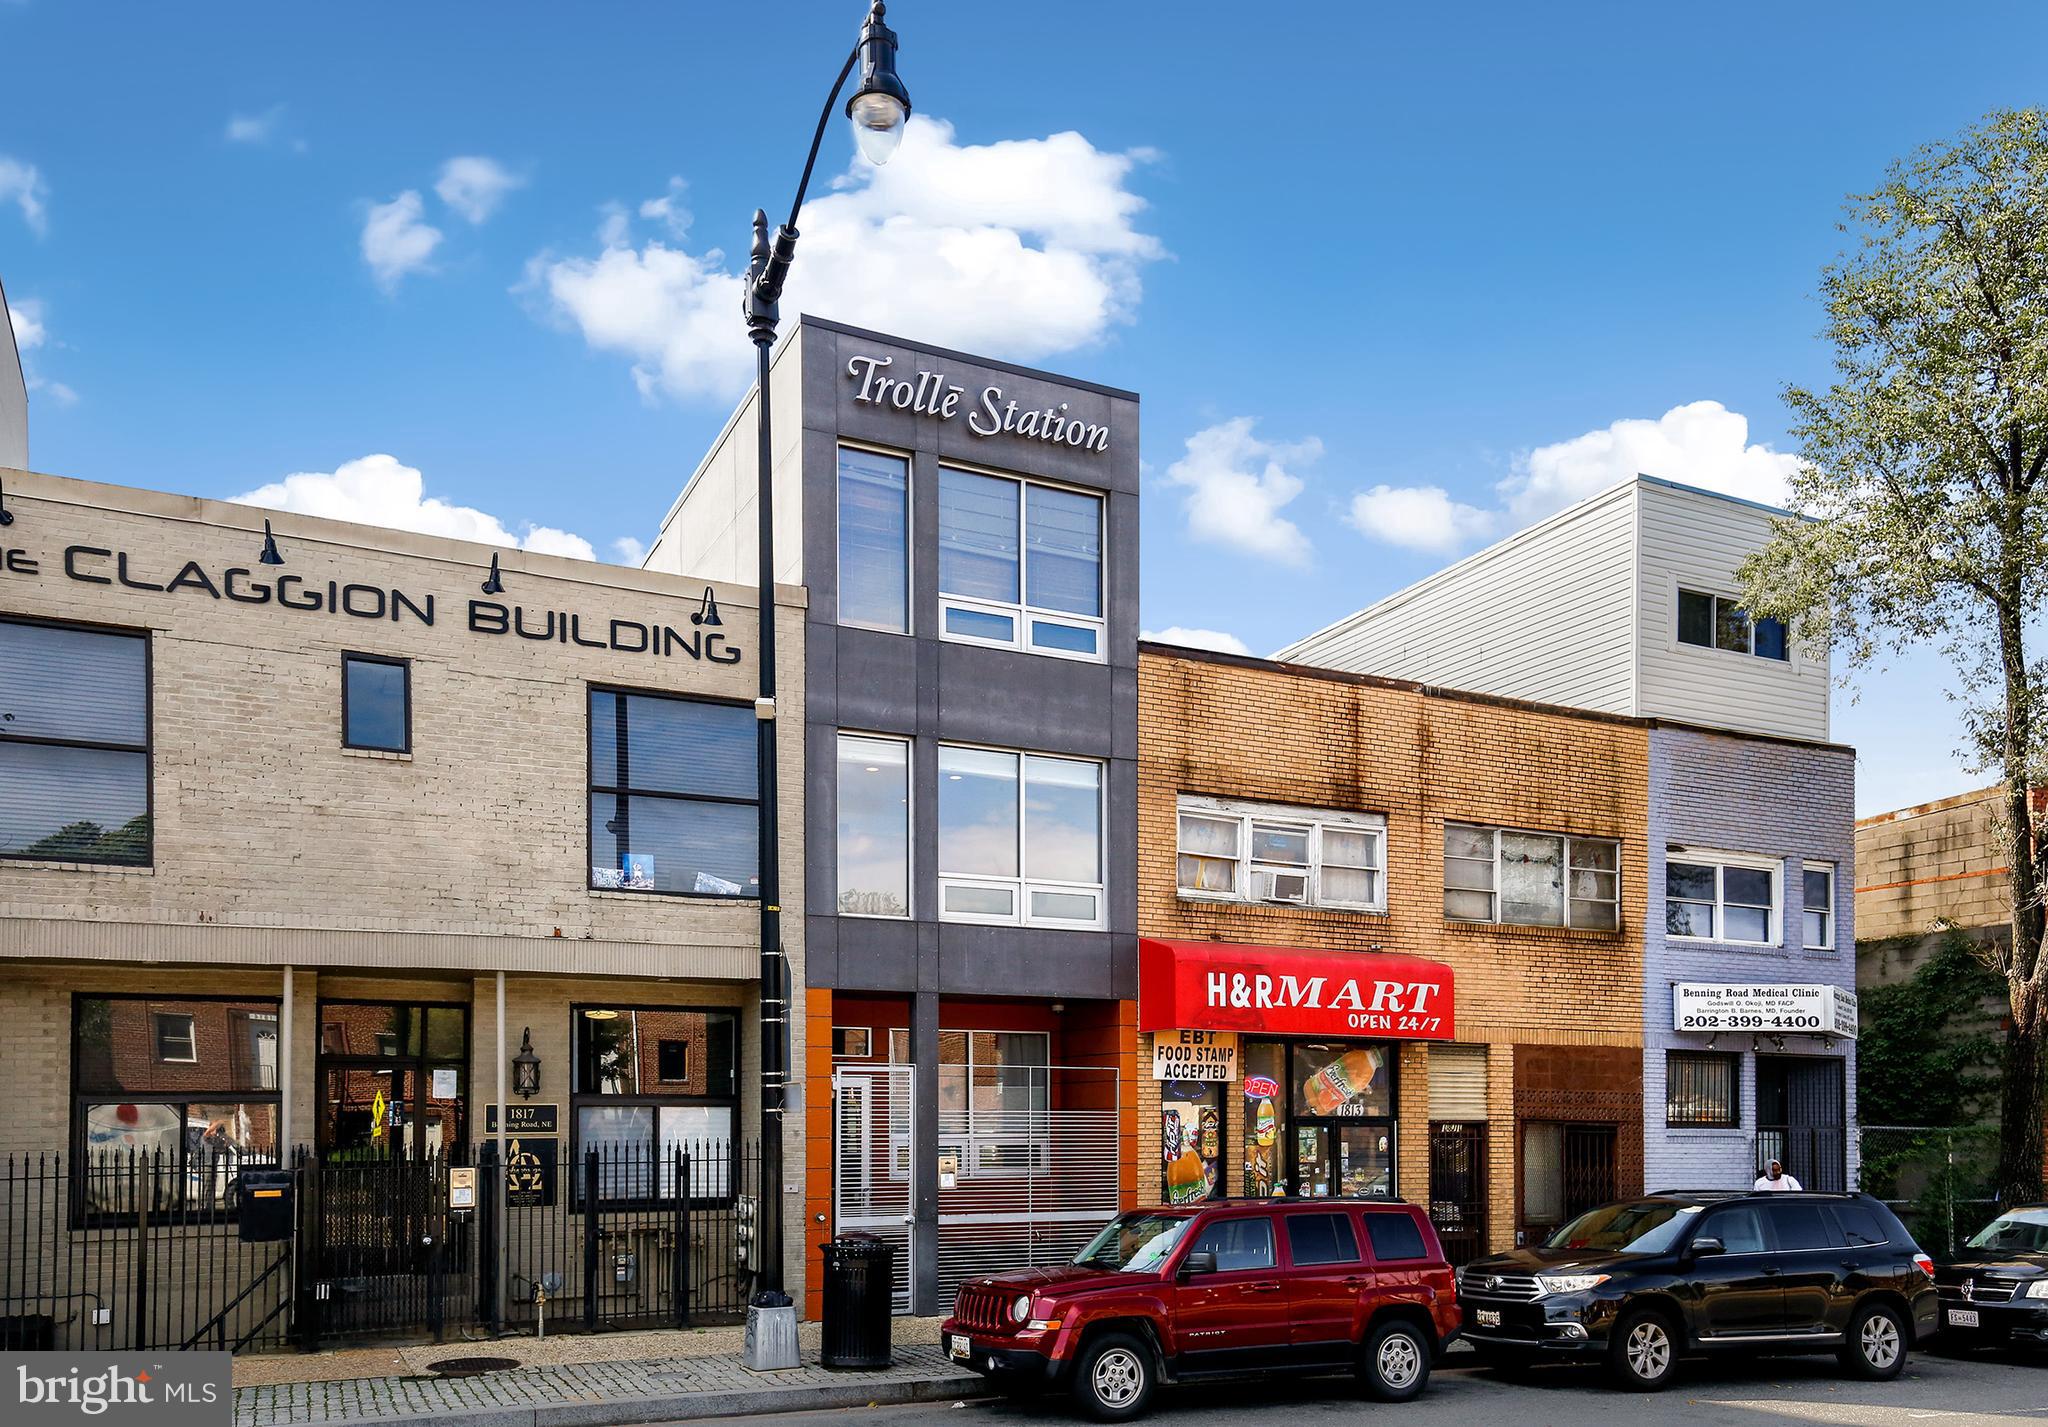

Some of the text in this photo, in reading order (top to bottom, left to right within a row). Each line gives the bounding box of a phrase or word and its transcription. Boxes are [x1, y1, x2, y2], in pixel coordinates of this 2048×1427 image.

[967, 385, 1110, 453] Station
[0, 545, 741, 664] E CLAGGION BUILDING
[1683, 988, 1820, 999] Benning Road Medical Clinic
[1347, 1013, 1441, 1032] OPEN 24/7
[1684, 1015, 1820, 1028] 202-399-4400
[1180, 1030, 1217, 1045] EBT
[1157, 1045, 1234, 1063] FOOD STAMP
[1164, 1063, 1227, 1079] ACCEPTED
[1244, 1079, 1279, 1097] OPEN
[511, 1108, 535, 1119] 1817
[541, 1120, 553, 1128] NE
